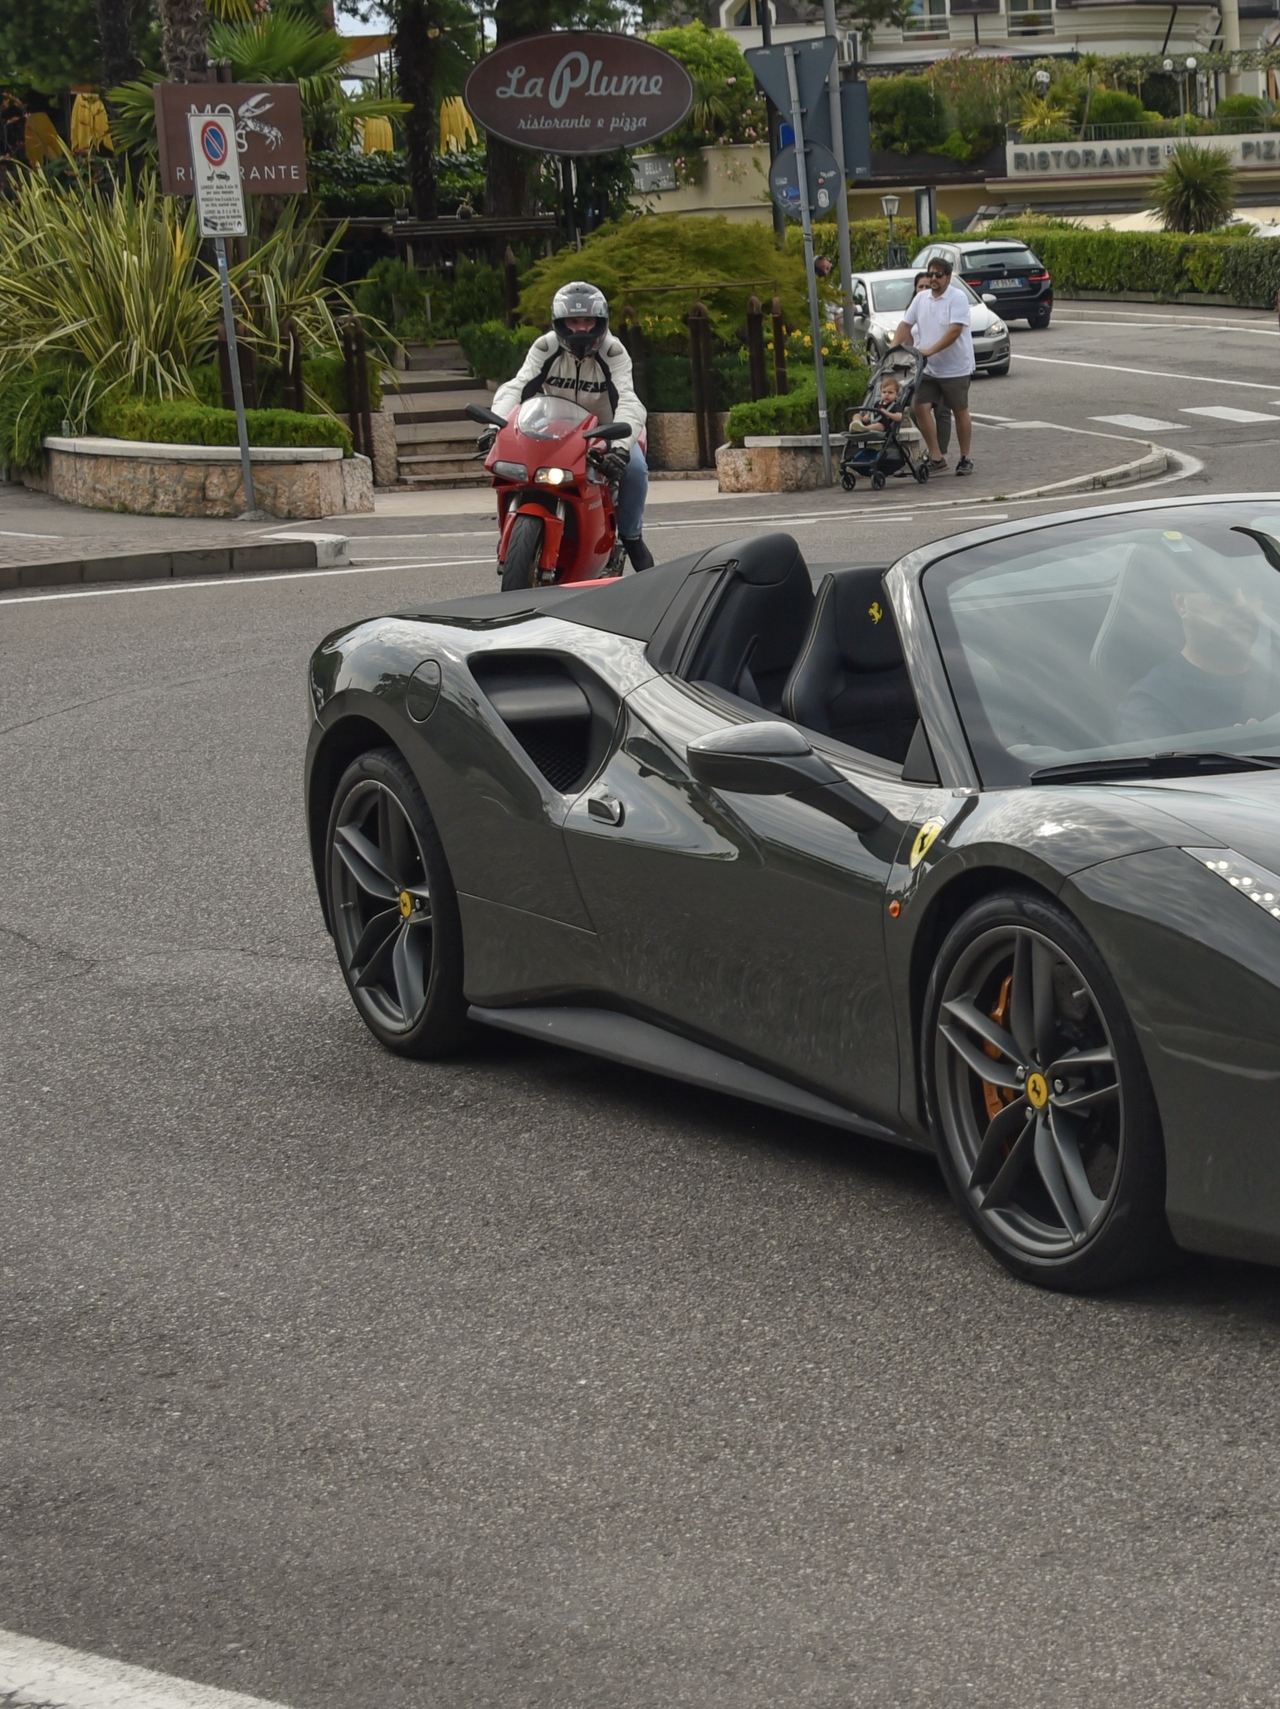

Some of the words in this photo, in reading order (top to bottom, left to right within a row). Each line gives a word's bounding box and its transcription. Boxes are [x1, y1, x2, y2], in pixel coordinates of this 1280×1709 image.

[495, 65, 545, 99] La
[548, 51, 663, 109] Plume
[517, 114, 591, 130] ristorante
[597, 117, 604, 128] e
[609, 112, 647, 132] pizza
[1013, 145, 1160, 171] RISTORANTE
[176, 165, 300, 181] RIRANTE
